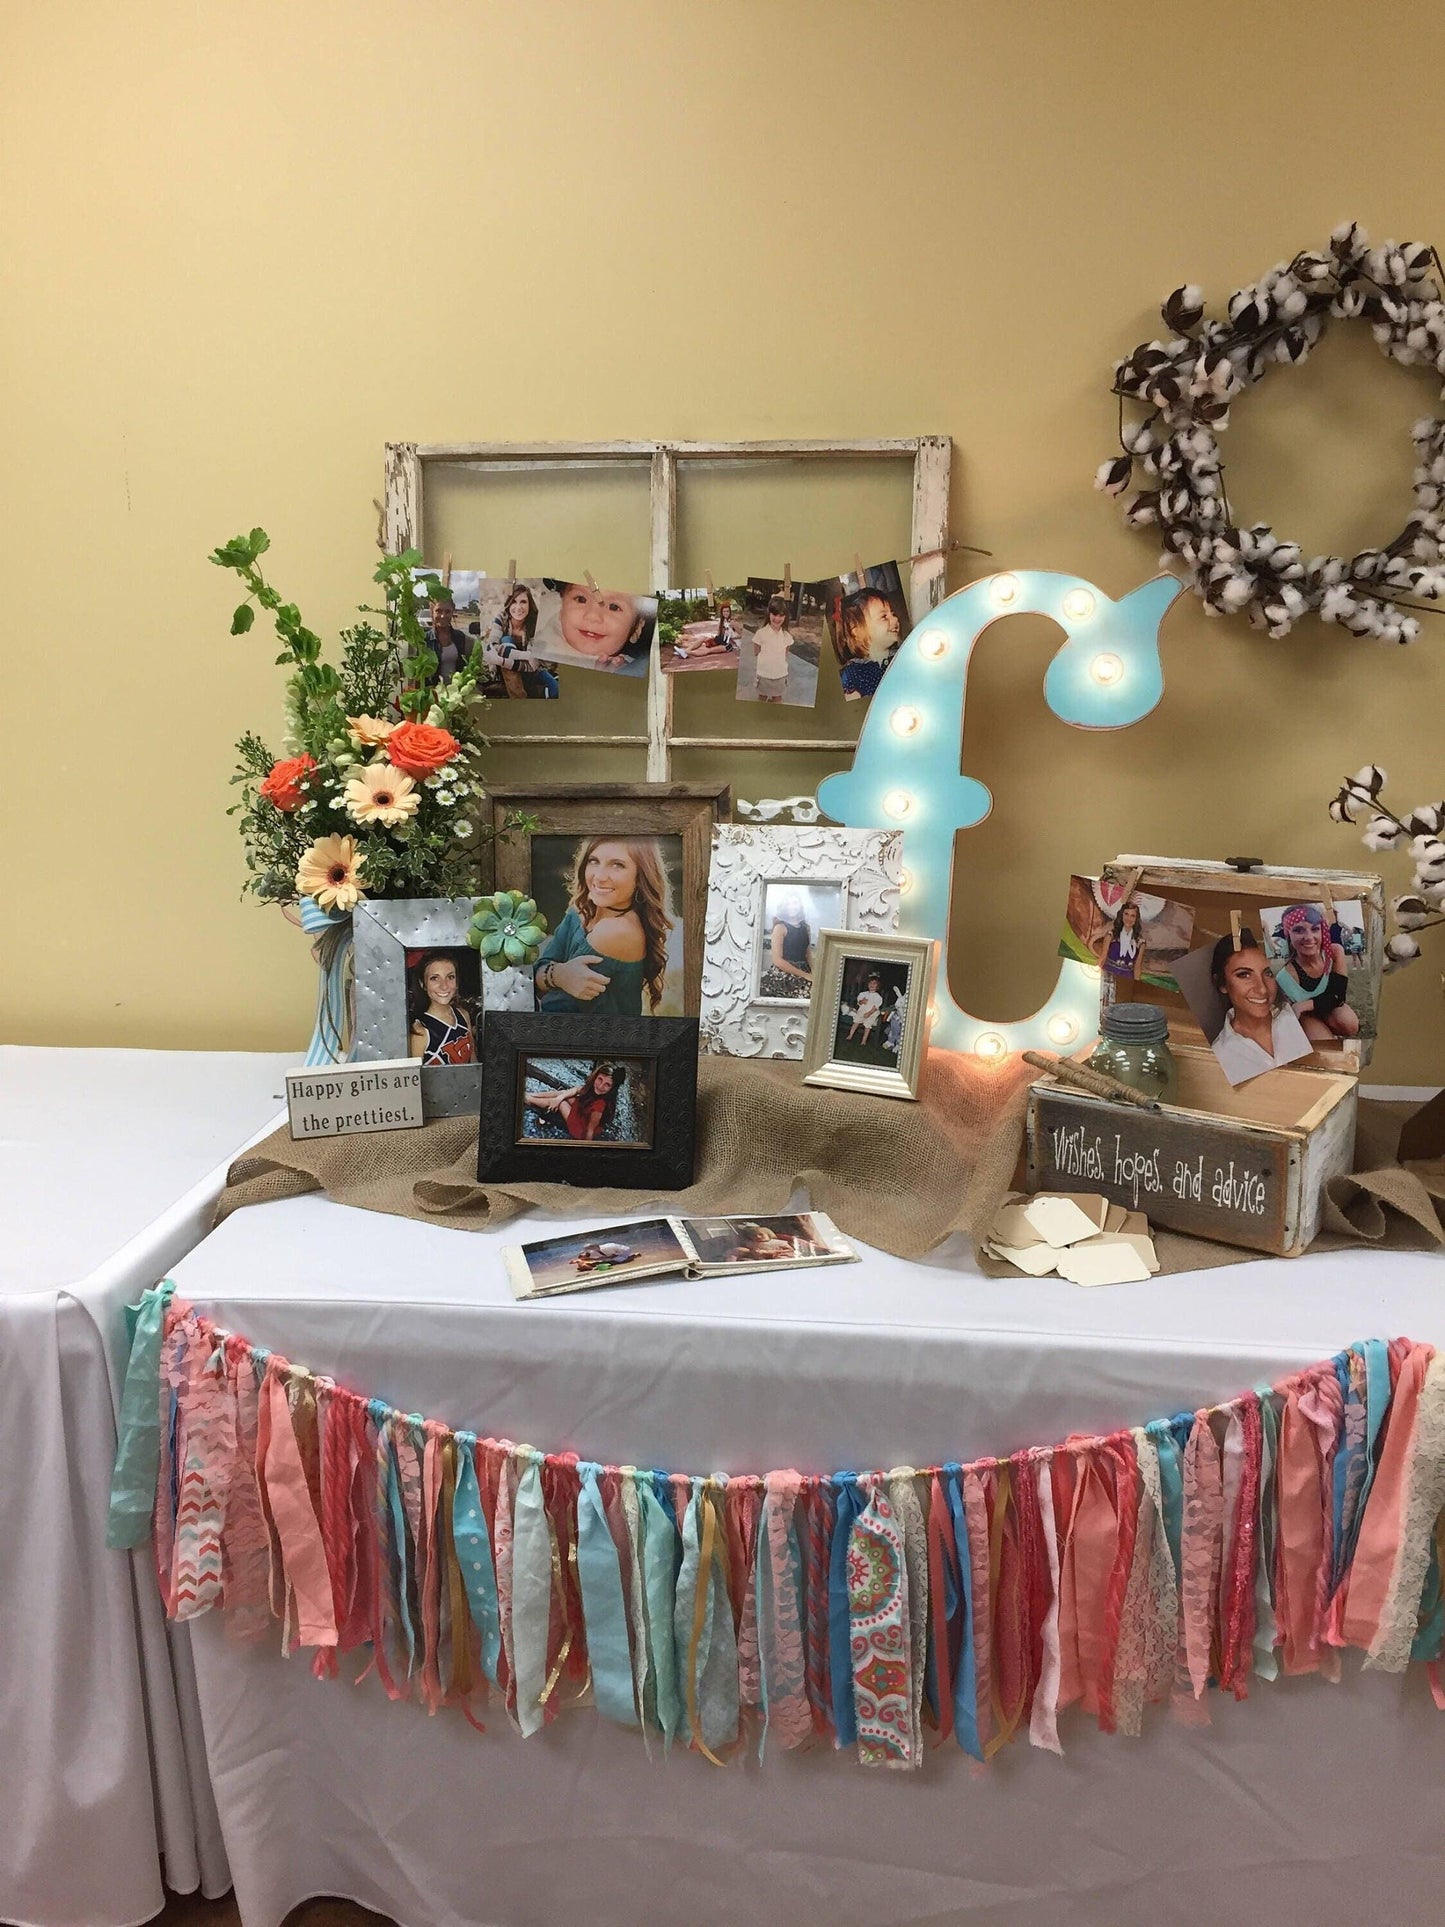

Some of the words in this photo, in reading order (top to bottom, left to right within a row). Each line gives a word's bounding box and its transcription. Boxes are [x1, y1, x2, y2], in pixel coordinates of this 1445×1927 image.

[292, 1081, 344, 1100] Happy
[350, 1073, 388, 1097] girls
[393, 1074, 420, 1089] are
[302, 1114, 330, 1132] the
[335, 1107, 415, 1132] prettiest.
[1053, 1125, 1105, 1181] Wishes,
[1113, 1134, 1163, 1209] hopes,
[1172, 1155, 1204, 1202] and
[1212, 1161, 1266, 1216] advice
